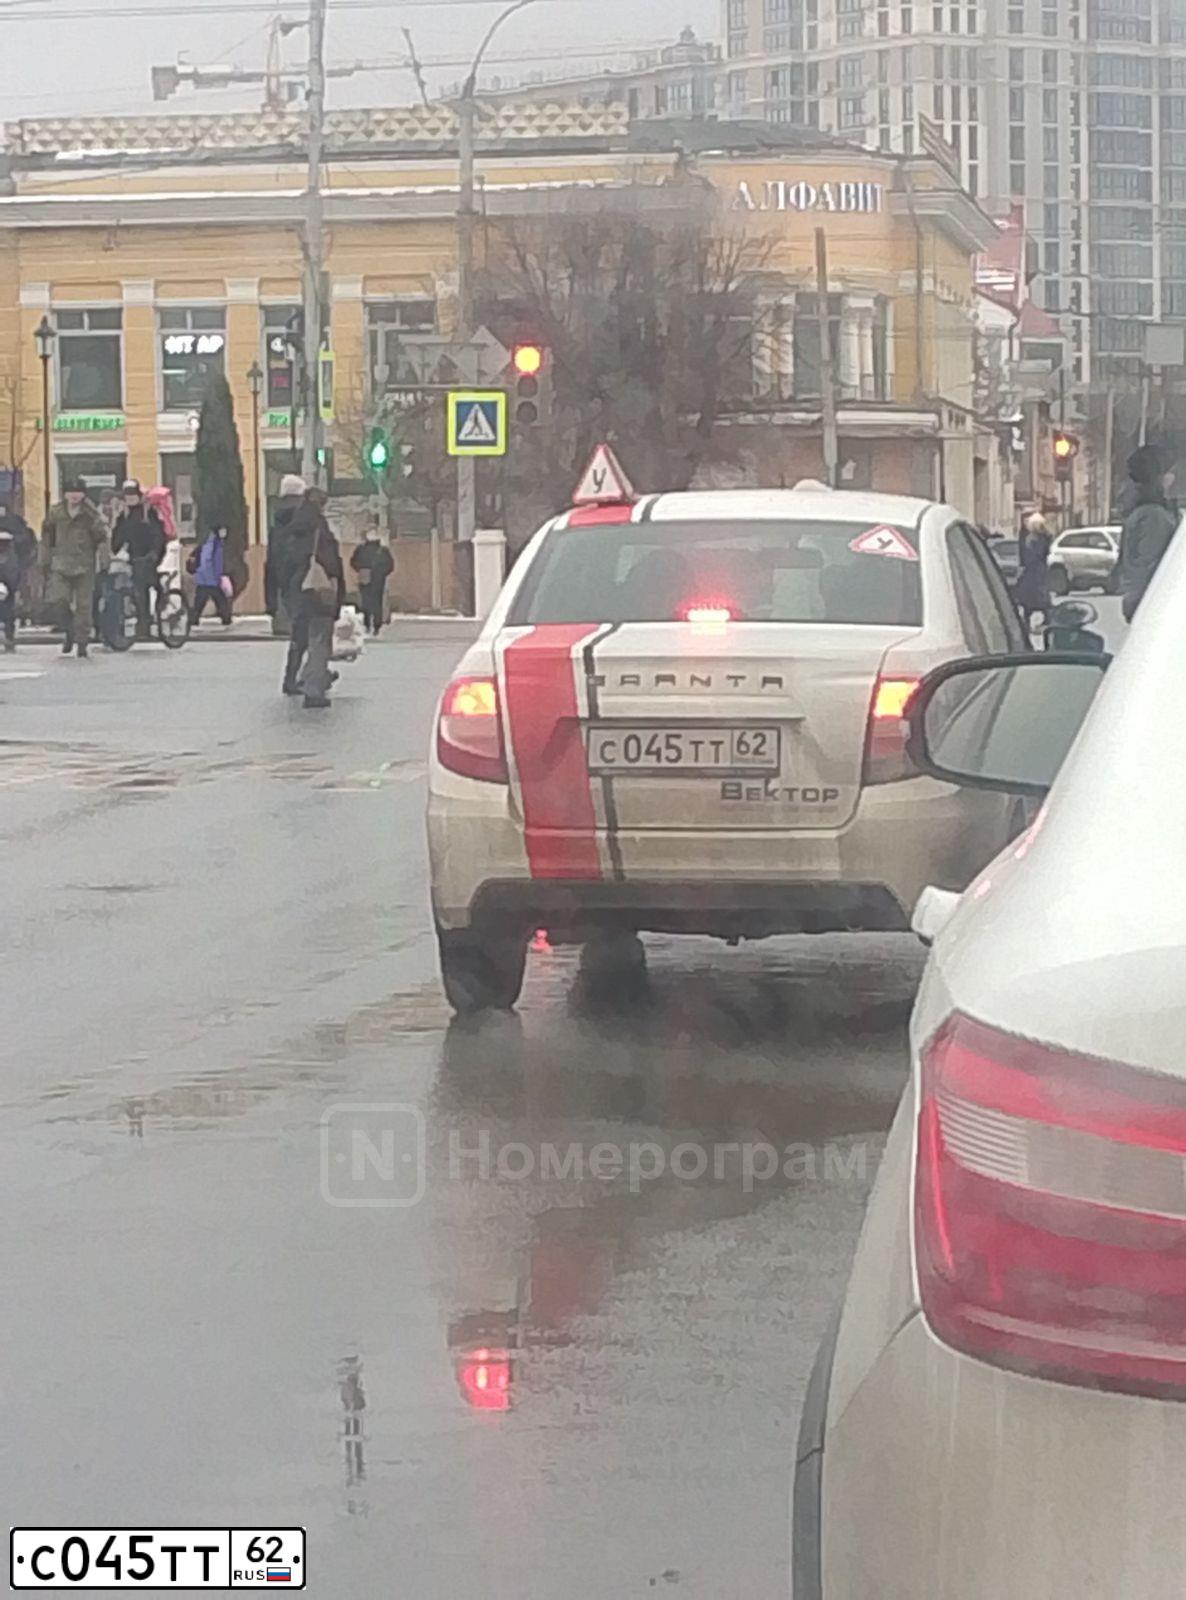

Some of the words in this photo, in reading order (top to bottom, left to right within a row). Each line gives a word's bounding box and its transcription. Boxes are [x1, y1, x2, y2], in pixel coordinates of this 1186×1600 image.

[732, 181, 883, 213] АЛФАВИТ
[592, 467, 607, 494] У
[599, 733, 725, 764] С045ТТ
[736, 731, 767, 756] 62
